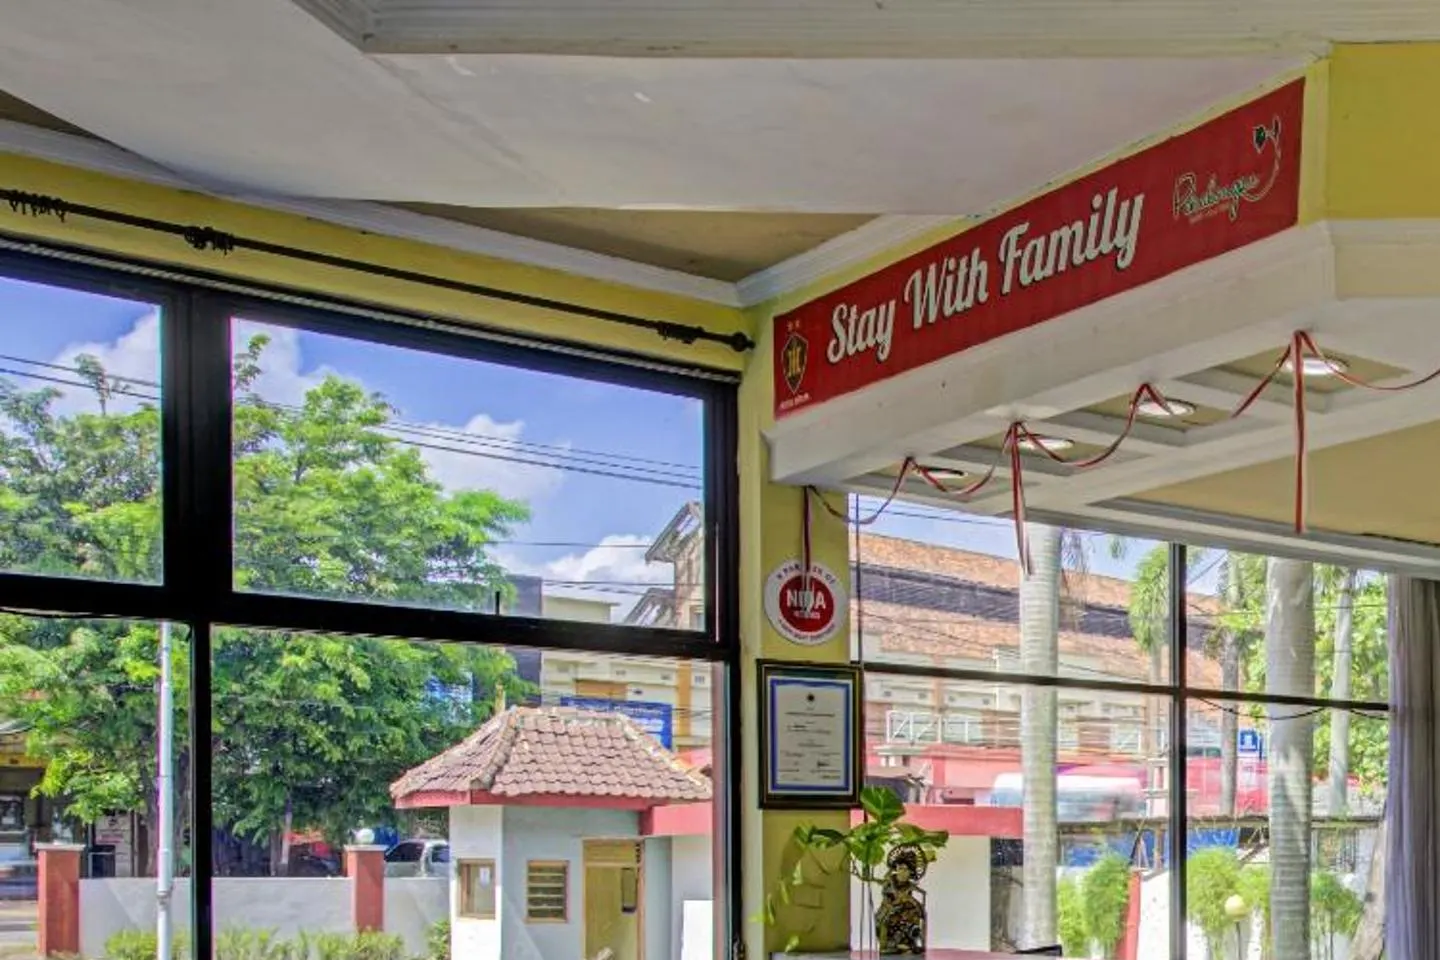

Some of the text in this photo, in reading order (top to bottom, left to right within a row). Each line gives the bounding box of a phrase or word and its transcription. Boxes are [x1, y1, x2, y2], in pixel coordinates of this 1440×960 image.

[827, 186, 1146, 362] Stay With Family
